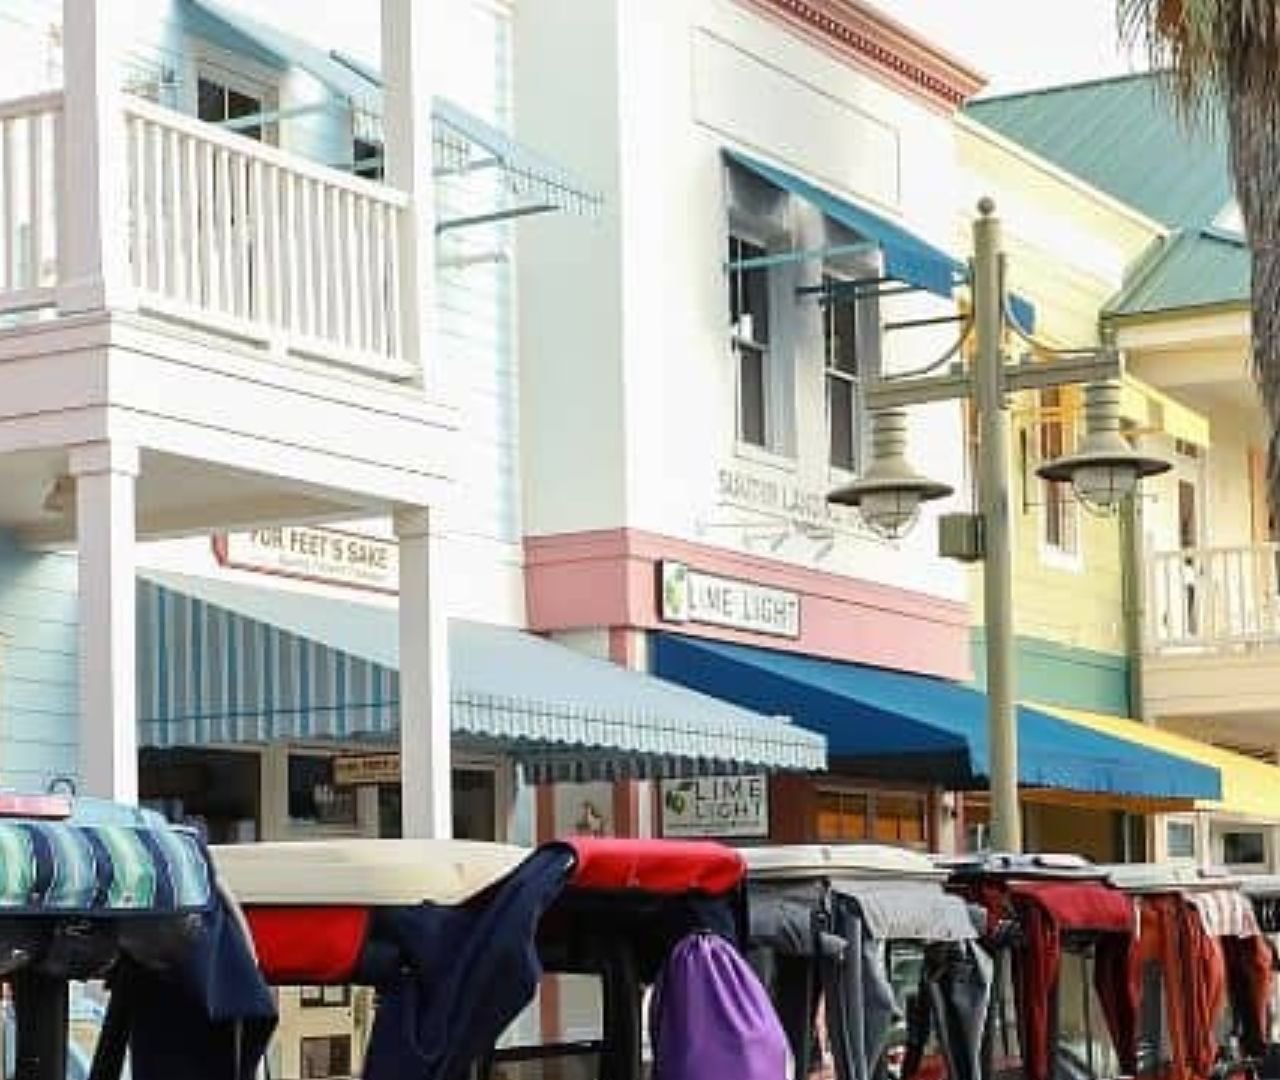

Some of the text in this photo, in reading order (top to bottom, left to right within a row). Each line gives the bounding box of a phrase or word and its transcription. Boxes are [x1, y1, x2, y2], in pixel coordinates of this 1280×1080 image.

[347, 540, 388, 569] SAKE
[687, 578, 796, 632] LIME LIGHT
[696, 778, 760, 801] LIME
[696, 800, 760, 819] LIGHT
